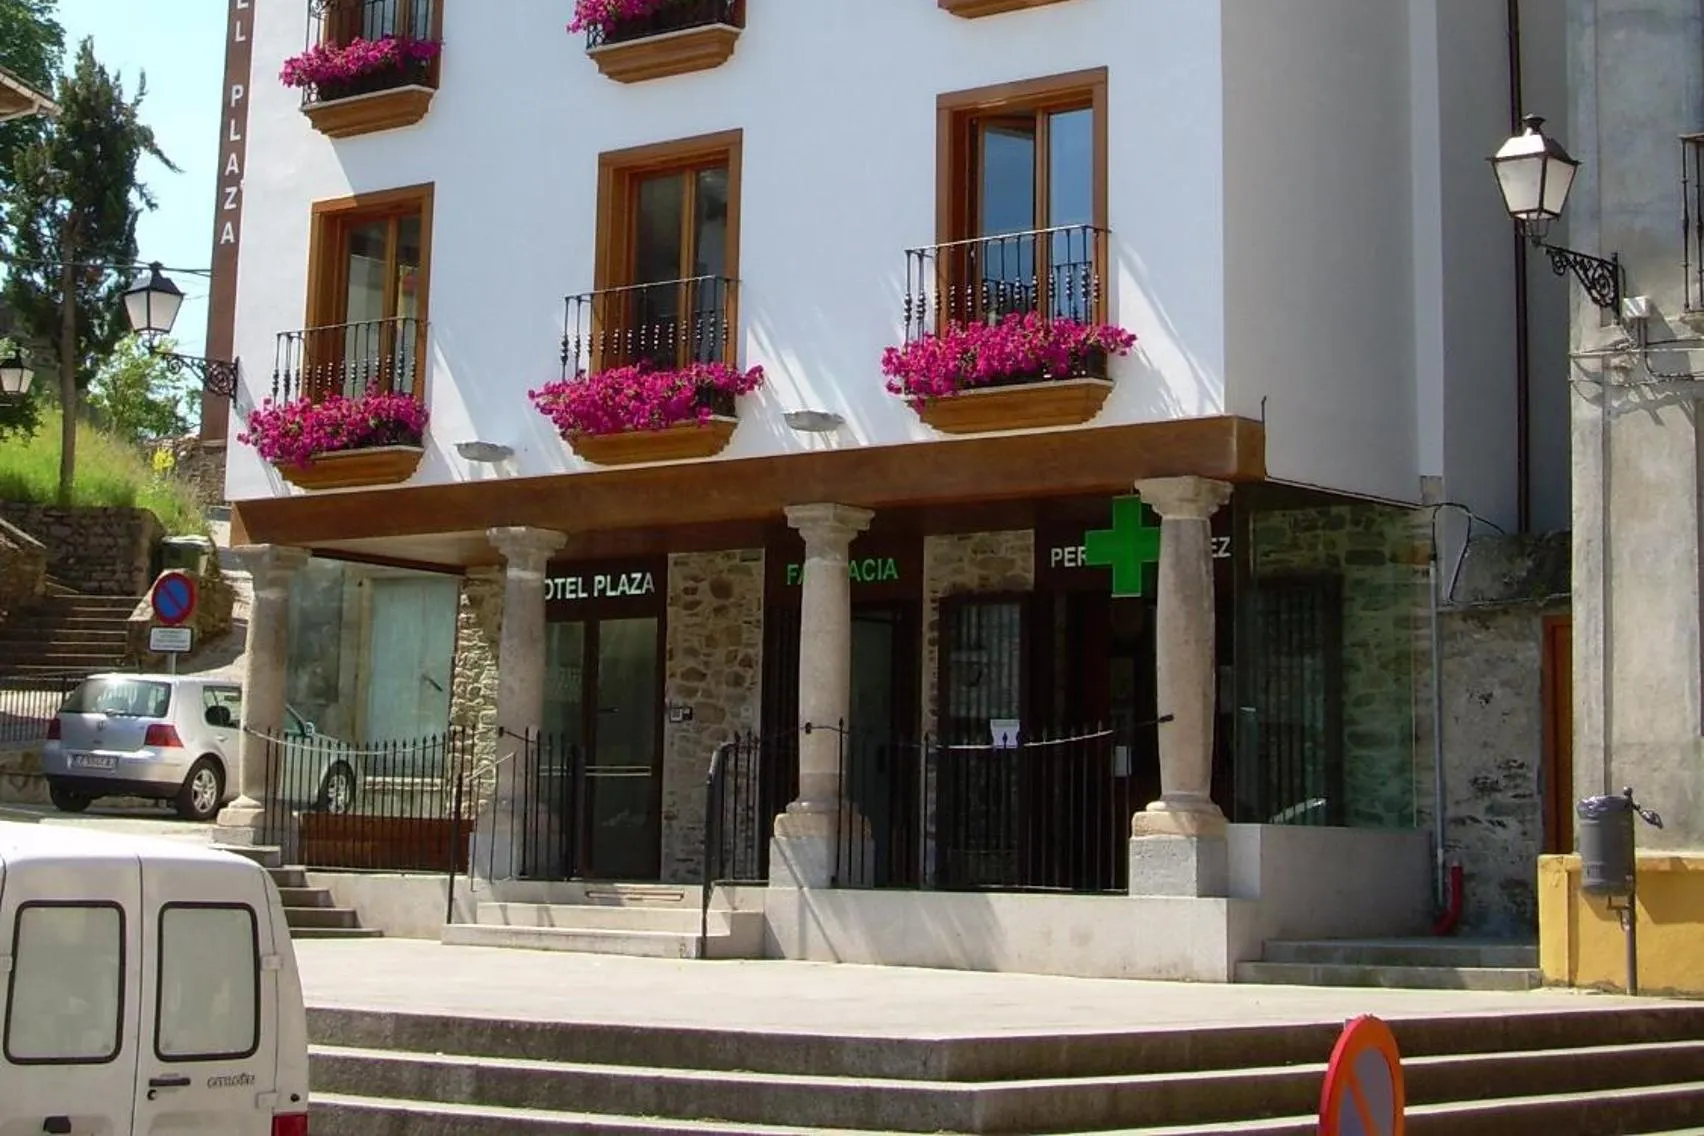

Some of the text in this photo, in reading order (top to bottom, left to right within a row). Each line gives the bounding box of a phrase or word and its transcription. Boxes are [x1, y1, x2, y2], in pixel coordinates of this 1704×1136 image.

[219, 83, 243, 245] PLAZA
[544, 571, 655, 600] OTEL PLAZA
[786, 557, 899, 585] FACIA
